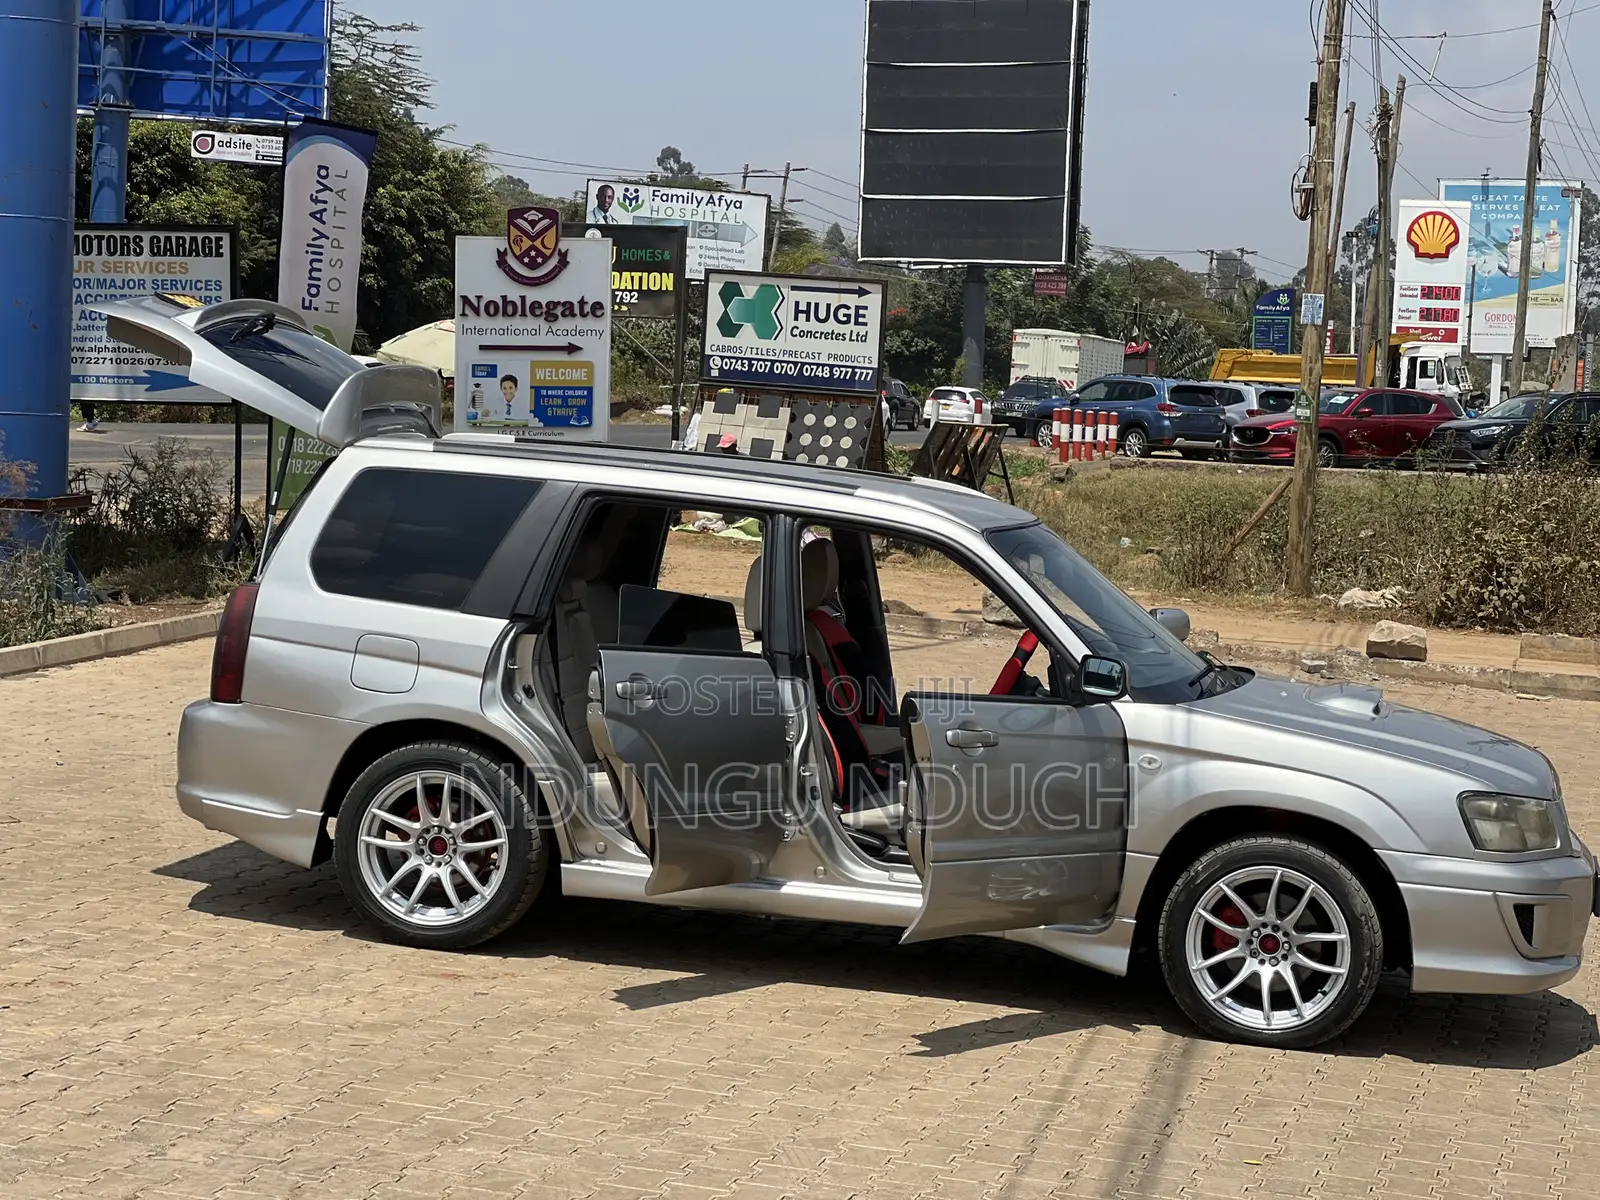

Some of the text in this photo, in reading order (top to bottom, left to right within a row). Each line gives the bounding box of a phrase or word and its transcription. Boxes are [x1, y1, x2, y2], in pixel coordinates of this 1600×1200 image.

[217, 137, 253, 150] adsite
[652, 189, 743, 212] Family Afya
[1471, 194, 1548, 202] GREAT TATE
[650, 205, 743, 224] HOSPITAL
[149, 235, 224, 258] GARAGE
[302, 165, 333, 311] Family Afya
[325, 170, 348, 314] HOSPITAL
[101, 261, 189, 275] SERVICES
[73, 277, 223, 292] OR/MAJOR SERVICES
[611, 271, 674, 291] DATION
[615, 291, 639, 303] 792
[459, 294, 606, 322] Noblegate
[793, 300, 869, 327] HUGE
[461, 325, 605, 340] International Academy
[790, 325, 869, 343] Concretes Ltd
[709, 343, 873, 365] CABROS/TILES/PRECAST PRODUCTS
[535, 368, 588, 381] WELCOME
[722, 358, 873, 382] 0743 707 070/ 0748 977 777
[78, 376, 135, 385] 100 Meters
[541, 397, 562, 406] LEARN
[568, 398, 587, 406] GROW
[278, 436, 304, 453] 018
[307, 438, 324, 454] 222
